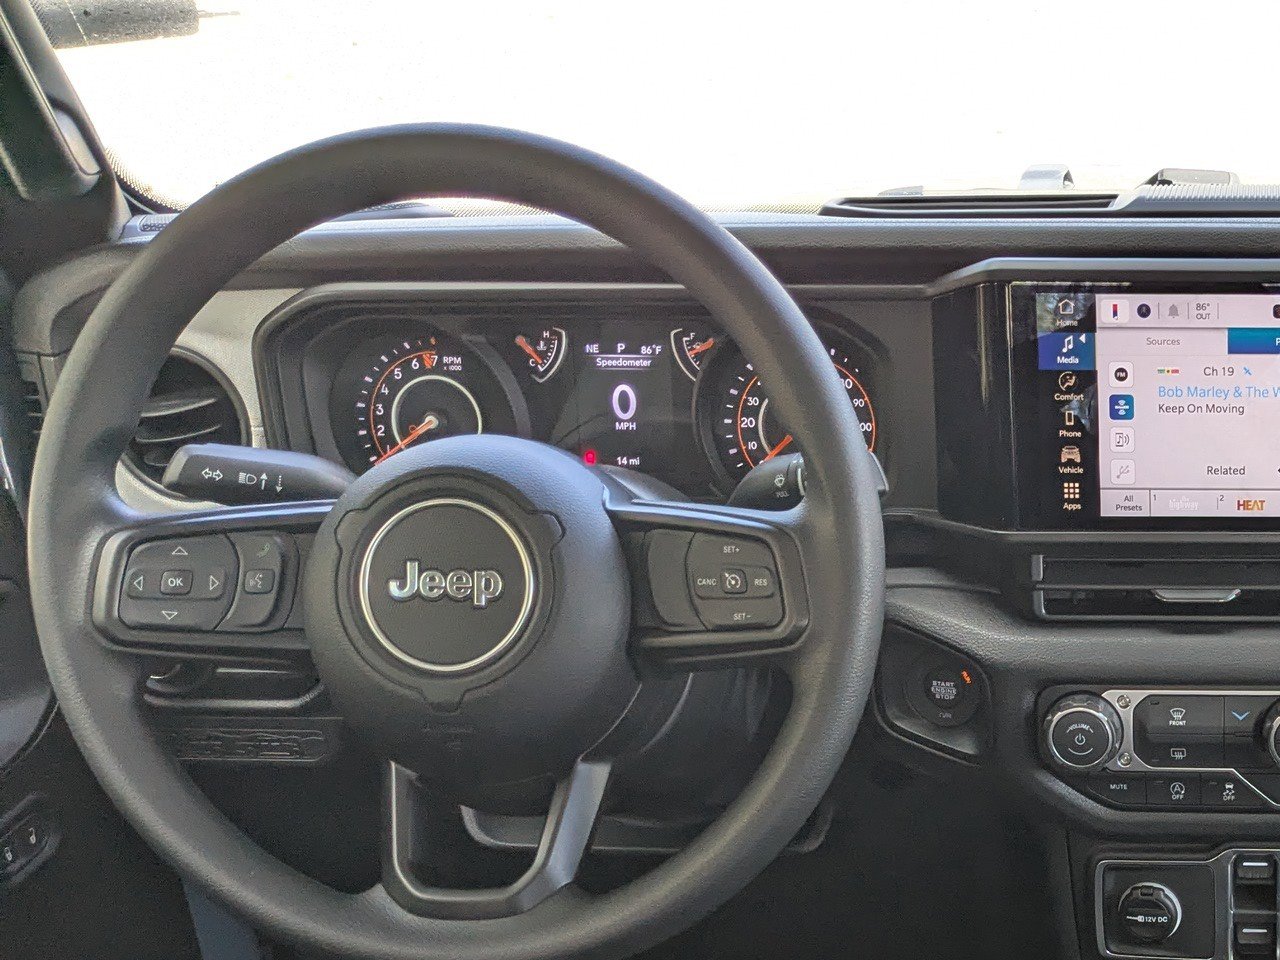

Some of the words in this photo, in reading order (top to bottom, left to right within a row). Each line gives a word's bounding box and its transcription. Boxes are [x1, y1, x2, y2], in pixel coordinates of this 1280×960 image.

[1195, 312, 1211, 320] OUT
[1056, 319, 1078, 327] Home
[1146, 336, 1181, 346] Sources
[586, 344, 599, 353] NE
[617, 343, 626, 353] P
[641, 344, 662, 355] 86°F
[411, 358, 420, 370] 6
[430, 355, 439, 366] 7
[443, 356, 462, 364] RPM
[596, 357, 651, 368] Speedometer
[1056, 356, 1079, 364] Media
[394, 368, 403, 380] 5
[1203, 367, 1218, 376] Ch
[1221, 367, 1235, 376] 19
[381, 384, 389, 395] 4
[1158, 386, 1183, 398] Bob
[1187, 386, 1229, 400] Marley
[1233, 386, 1243, 398] &
[1245, 386, 1269, 398] The
[747, 397, 760, 406] 30
[1054, 393, 1084, 401] Comfort
[612, 384, 637, 420] 0
[853, 398, 865, 407] 90
[376, 403, 384, 415] 3
[1158, 403, 1185, 415] Keep
[1187, 404, 1203, 413] On
[1205, 403, 1245, 416] Moving
[615, 422, 637, 431] MPH
[741, 417, 756, 428] 20
[377, 425, 386, 436] 2
[1059, 430, 1082, 438] Phone
[748, 441, 758, 450] 10
[616, 456, 628, 465] 14
[629, 457, 640, 465] mi
[1058, 466, 1084, 474] Vehicle
[1207, 466, 1246, 476] Related
[1063, 502, 1082, 511] Apps
[1115, 504, 1143, 512] Presets
[1237, 500, 1265, 511] HEAT
[168, 578, 184, 587] OK
[389, 560, 503, 606] Jeep
[697, 578, 717, 586] CANC
[754, 578, 767, 586] RES
[1069, 723, 1091, 731] VOLUME
